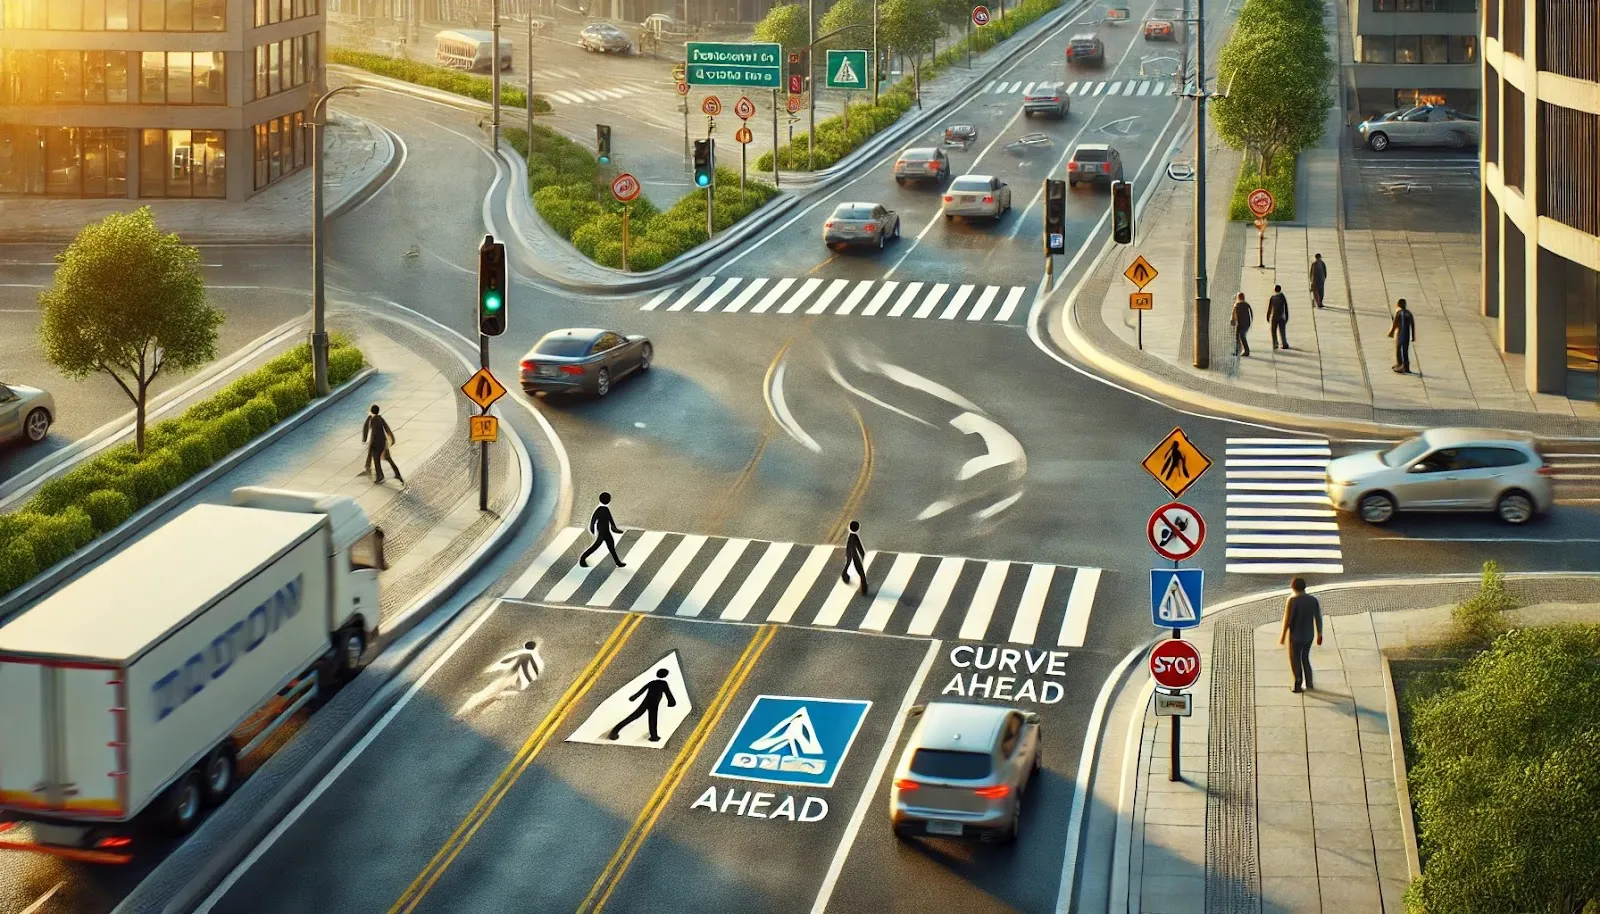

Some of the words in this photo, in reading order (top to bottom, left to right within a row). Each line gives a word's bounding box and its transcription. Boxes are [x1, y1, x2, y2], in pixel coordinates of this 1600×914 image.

[950, 645, 1069, 676] CURVE
[941, 672, 1065, 704] AHEAD
[690, 786, 829, 822] AHEAD
